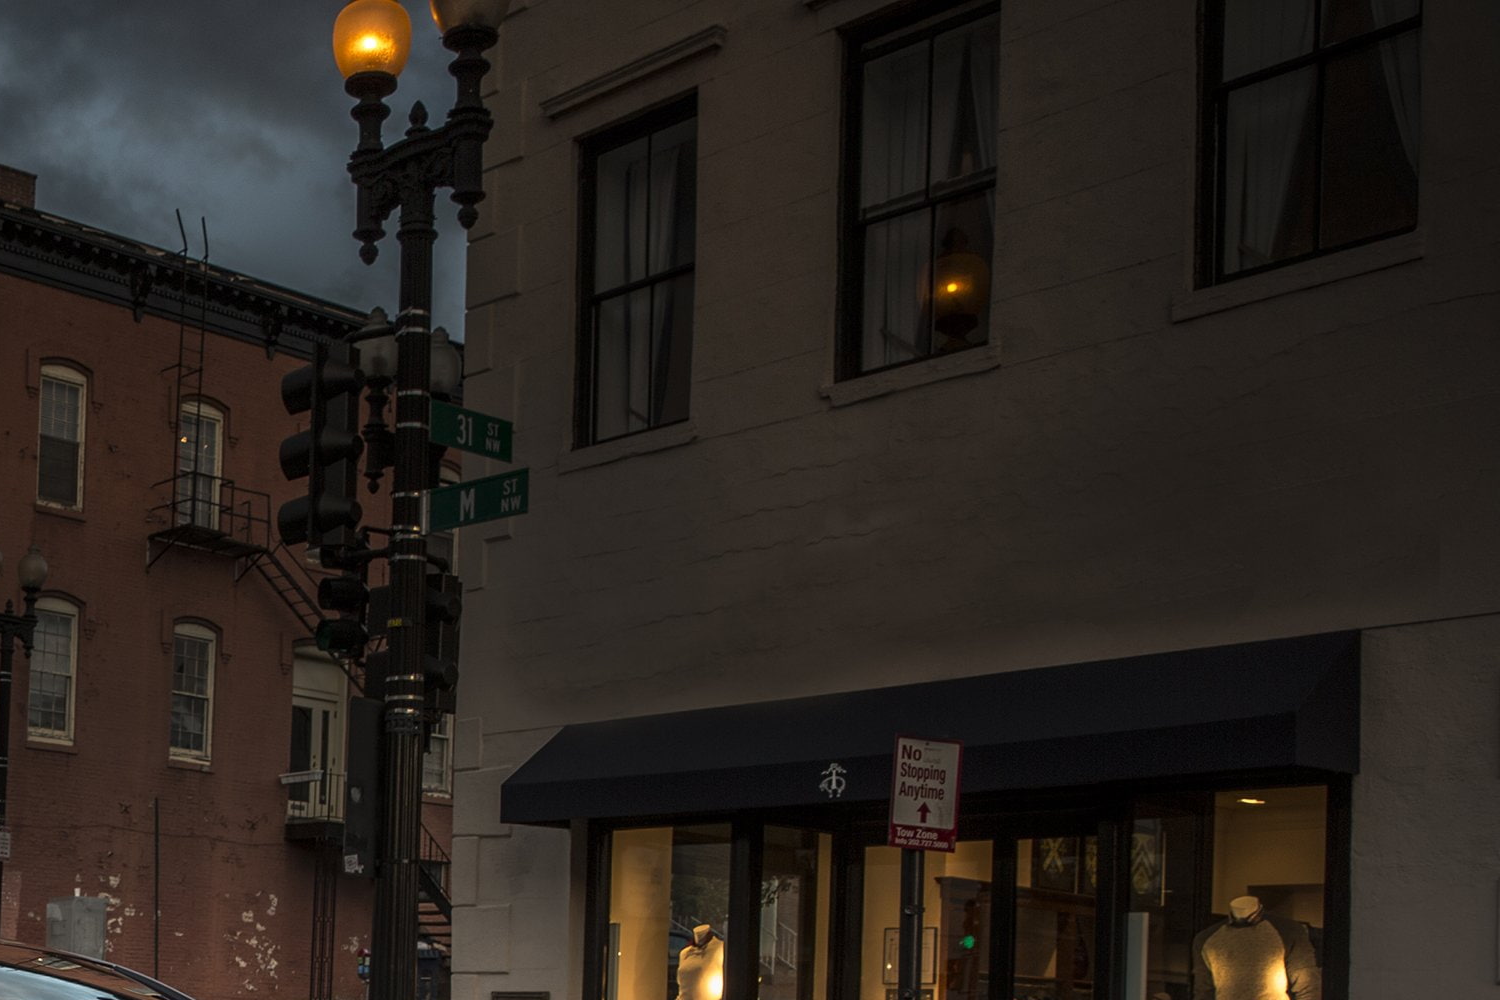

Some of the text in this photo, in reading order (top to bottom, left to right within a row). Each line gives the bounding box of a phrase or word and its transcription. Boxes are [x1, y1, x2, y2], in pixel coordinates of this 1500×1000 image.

[456, 413, 474, 447] 31
[486, 422, 500, 437] ST
[485, 438, 501, 453] NW
[503, 478, 519, 496] ST
[460, 488, 476, 521] M
[501, 495, 522, 513] NW
[901, 745, 922, 761] No
[900, 762, 947, 784] Stopping
[899, 781, 945, 801] Anytime
[896, 826, 939, 840] Tow Zone
